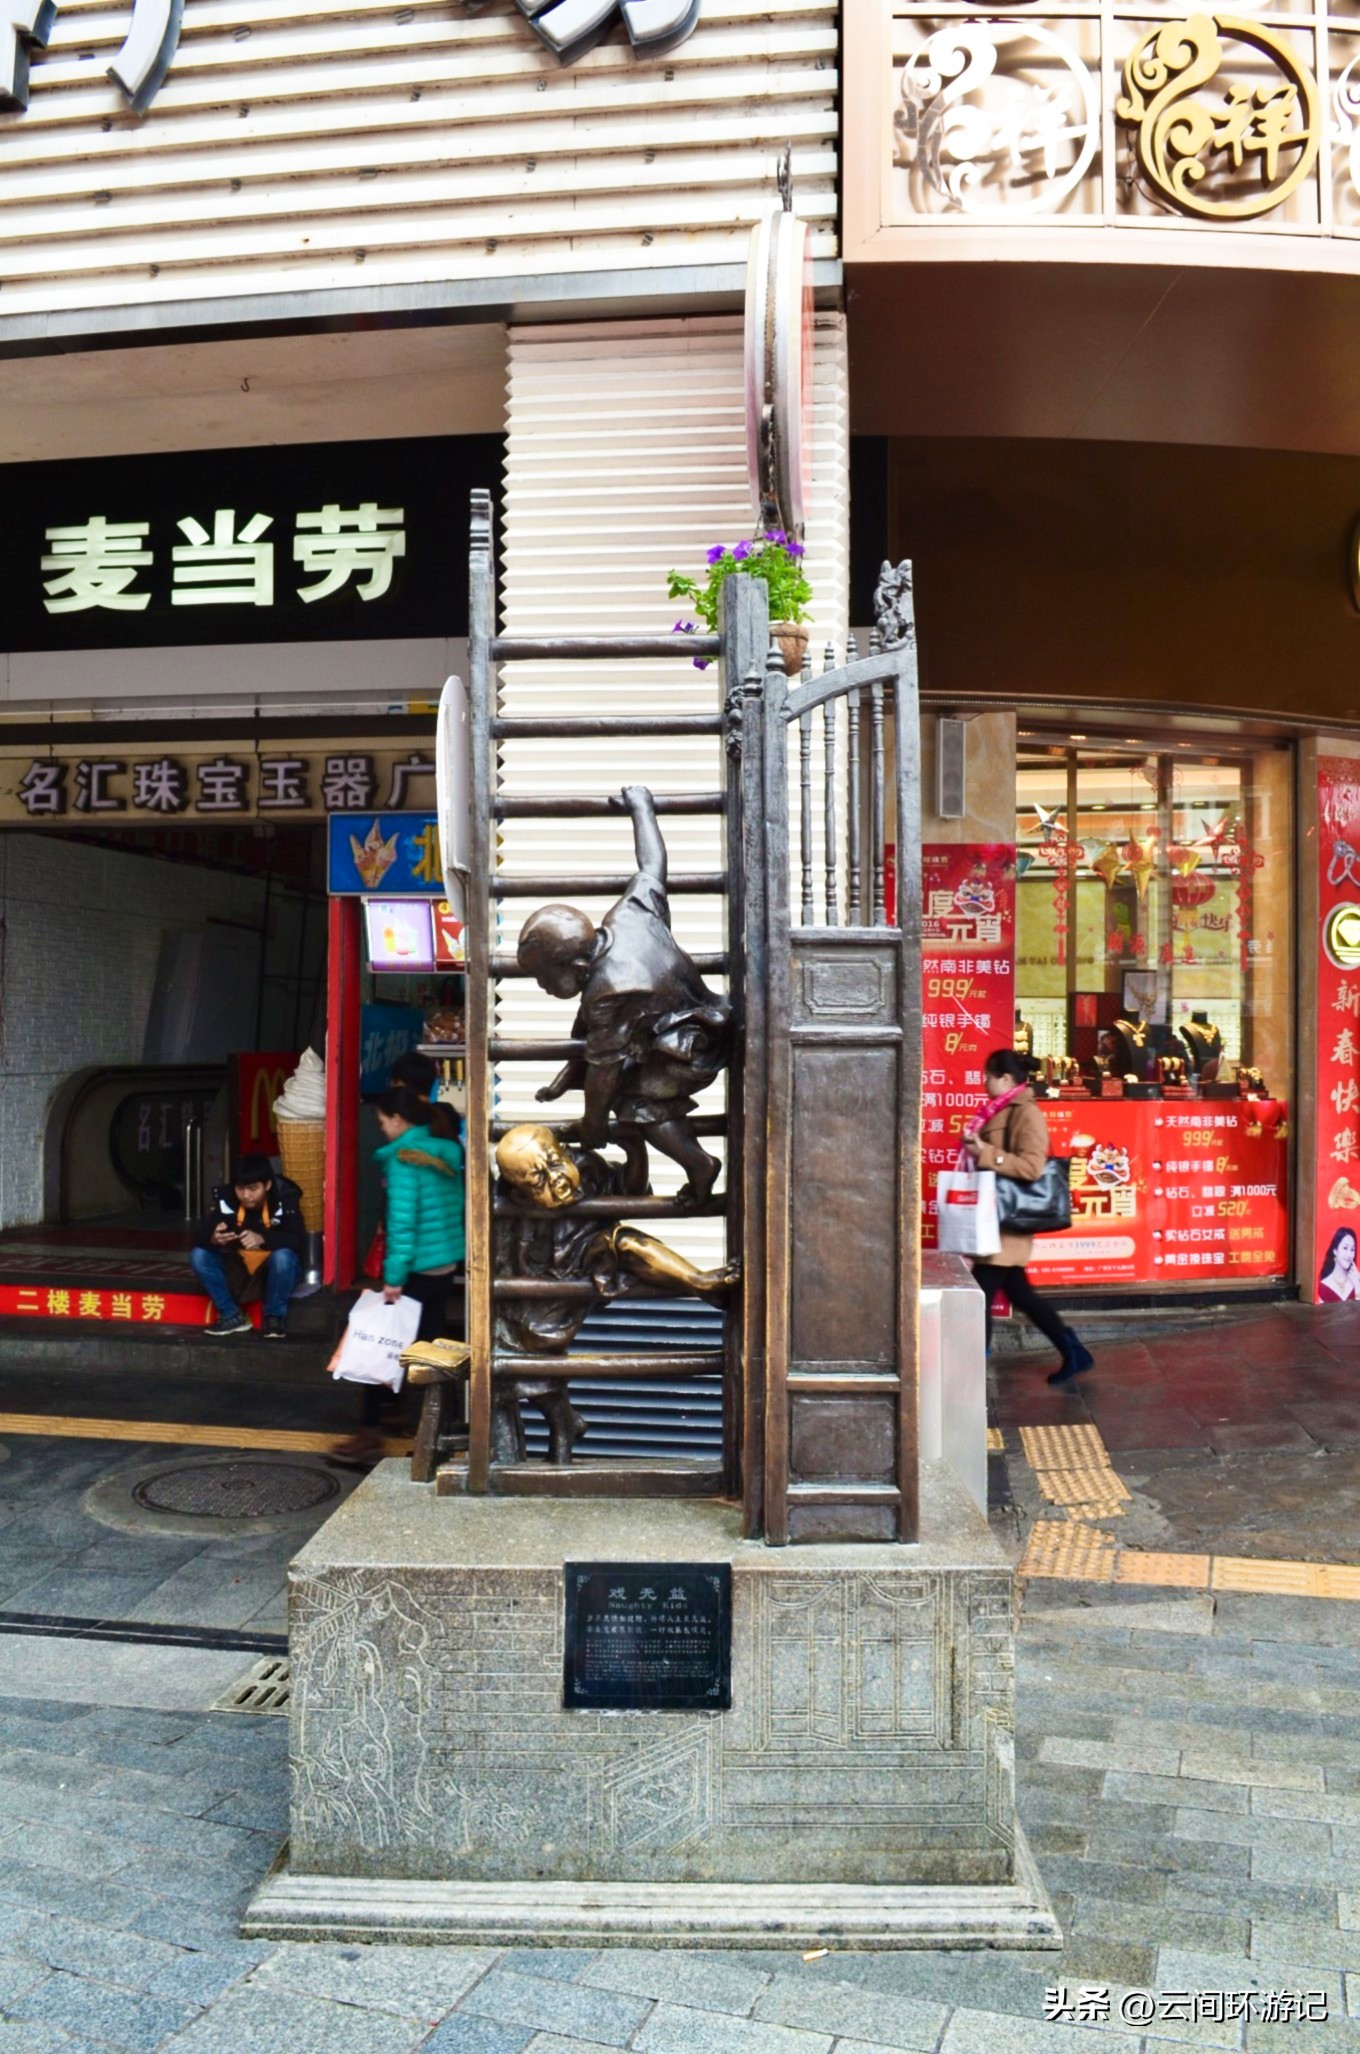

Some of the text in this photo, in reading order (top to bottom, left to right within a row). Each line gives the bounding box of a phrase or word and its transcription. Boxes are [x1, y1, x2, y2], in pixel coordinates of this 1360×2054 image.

[41, 503, 406, 614] 麦当劳
[18, 756, 436, 812] 名汇珠宝玉器广
[922, 960, 1010, 974] 然南非美钻
[17, 1288, 165, 1321] 二楼麦当劳
[608, 1601, 653, 1610] Naughty
